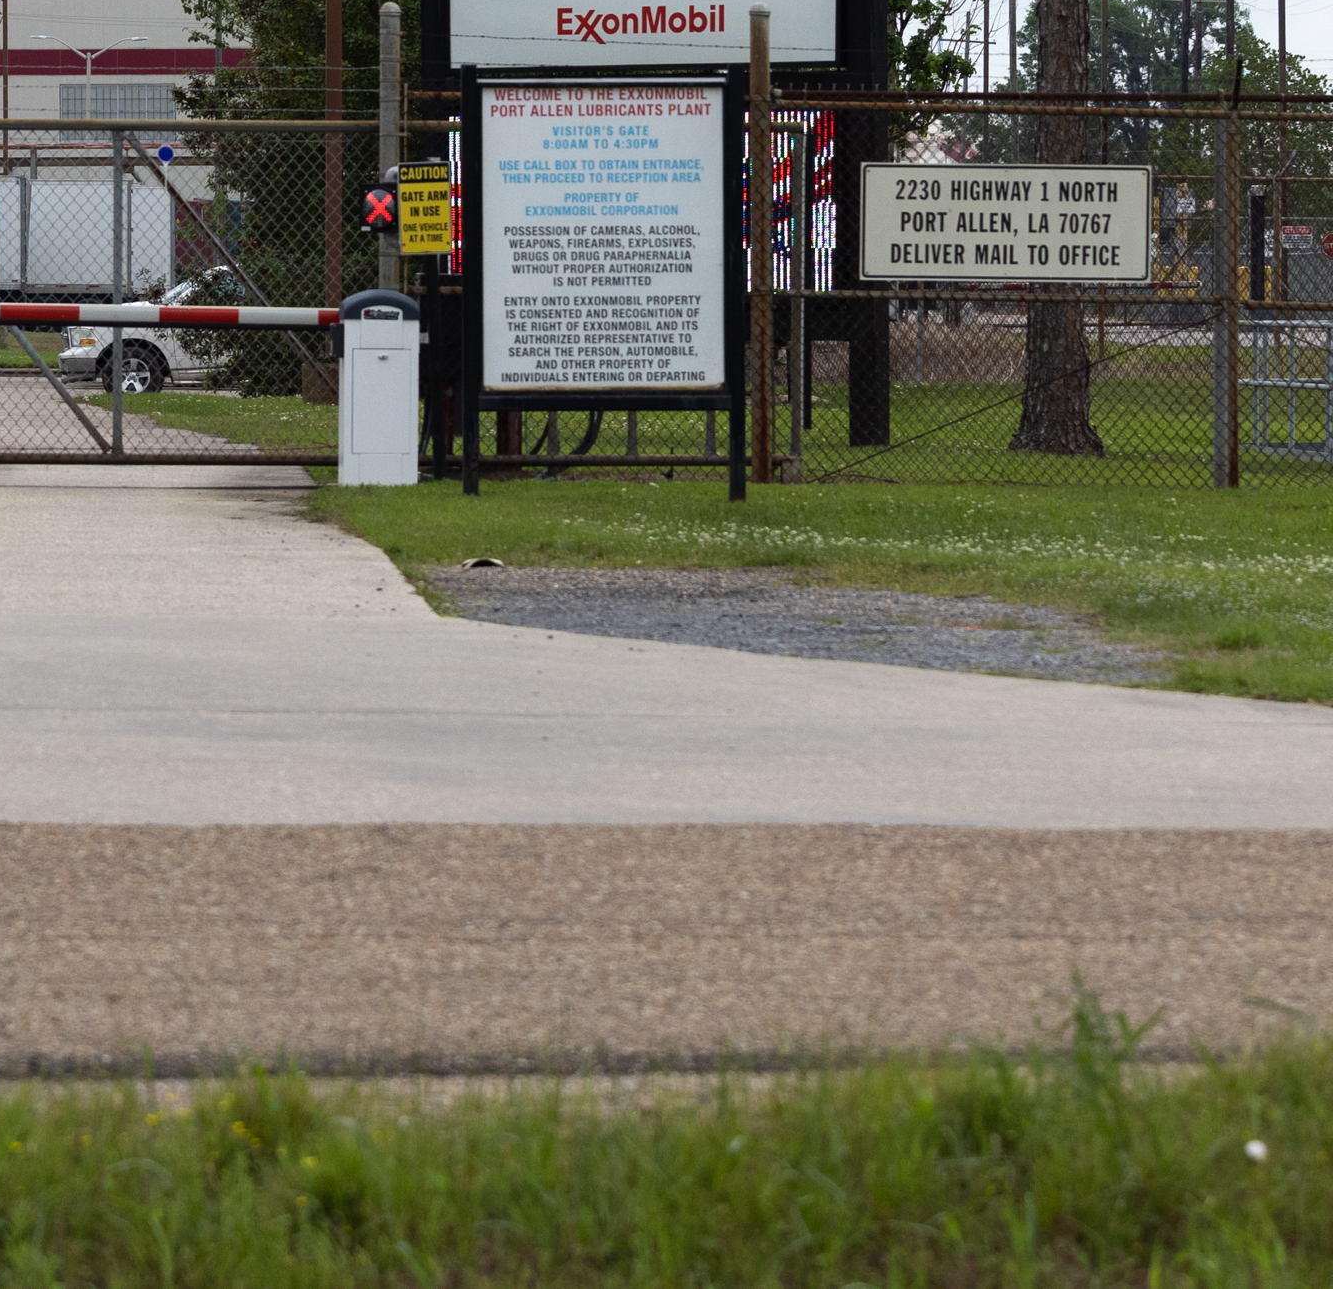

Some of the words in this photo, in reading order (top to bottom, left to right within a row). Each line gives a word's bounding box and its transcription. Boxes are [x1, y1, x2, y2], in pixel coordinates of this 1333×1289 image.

[557, 5, 725, 45] ExxonMobil
[494, 87, 562, 101] WELCOME
[568, 87, 585, 100] TO
[589, 87, 614, 100] THE
[618, 87, 709, 100] EXXONMOBIL
[490, 105, 525, 117] PORT
[530, 105, 573, 116] ALLEN
[578, 104, 663, 116] LUBRICANTS
[668, 103, 712, 115] PLANT
[552, 126, 614, 136] VISITOR'S
[618, 126, 649, 136] GATE
[543, 139, 588, 149] 8:00AM
[594, 139, 609, 149] TO
[613, 139, 659, 149] 4:30PM
[499, 160, 520, 170] USE
[523, 160, 551, 170] CALL
[555, 160, 577, 170] BOX
[581, 160, 595, 170] TO
[598, 160, 639, 170] OBTAIN
[642, 159, 704, 170] ENTRANCE,
[400, 166, 448, 180] CAUTION
[502, 173, 531, 183] THEN
[534, 173, 585, 183] PROCEED
[589, 173, 603, 183] TO
[606, 173, 668, 183] RECEPTION
[671, 172, 701, 182] AREA
[401, 191, 424, 202] GATE
[427, 191, 448, 201] ARM
[896, 180, 941, 200] 2230
[951, 181, 1031, 201] HIGHWAY
[1041, 182, 1048, 201] 1
[1059, 182, 1118, 202] NORTH
[564, 193, 621, 203] PROPERTY
[625, 192, 639, 203] OF
[410, 207, 420, 216] IN
[422, 206, 440, 216] USE
[525, 206, 597, 216] EXXONMOBIL
[600, 205, 679, 215] CORPORATION
[403, 224, 417, 232] ONE
[419, 223, 448, 231] VEHICLE
[901, 212, 947, 232] PORT
[956, 212, 1018, 237] ALLEN,
[1028, 213, 1049, 233] LA
[1059, 213, 1111, 234] 70767
[504, 226, 570, 236] POSSESSION
[573, 226, 587, 235] OF
[590, 226, 645, 235] CAMERAS,
[648, 225, 700, 235] ALCOHOL,
[409, 234, 417, 242] AT
[427, 234, 443, 242] TIME
[509, 239, 564, 248] WEAPONS,
[567, 238, 625, 248] FIREARMS,
[628, 238, 696, 248] EXPLOSIVES,
[513, 252, 549, 261] DRUGS
[552, 251, 567, 261] OR
[571, 251, 600, 261] DRUG
[603, 251, 692, 260] PARAPHERNALIA
[891, 244, 965, 264] DELIVER
[975, 244, 1018, 264] MAIL
[1028, 245, 1049, 265] TO
[1059, 245, 1120, 265] OFFICE
[512, 264, 559, 274] WITHOUT
[563, 264, 605, 273] PROPER
[608, 263, 693, 273] AUTHORIZATION
[553, 277, 564, 286] IS
[567, 277, 587, 286] NOT
[591, 276, 652, 286] PERMITTED
